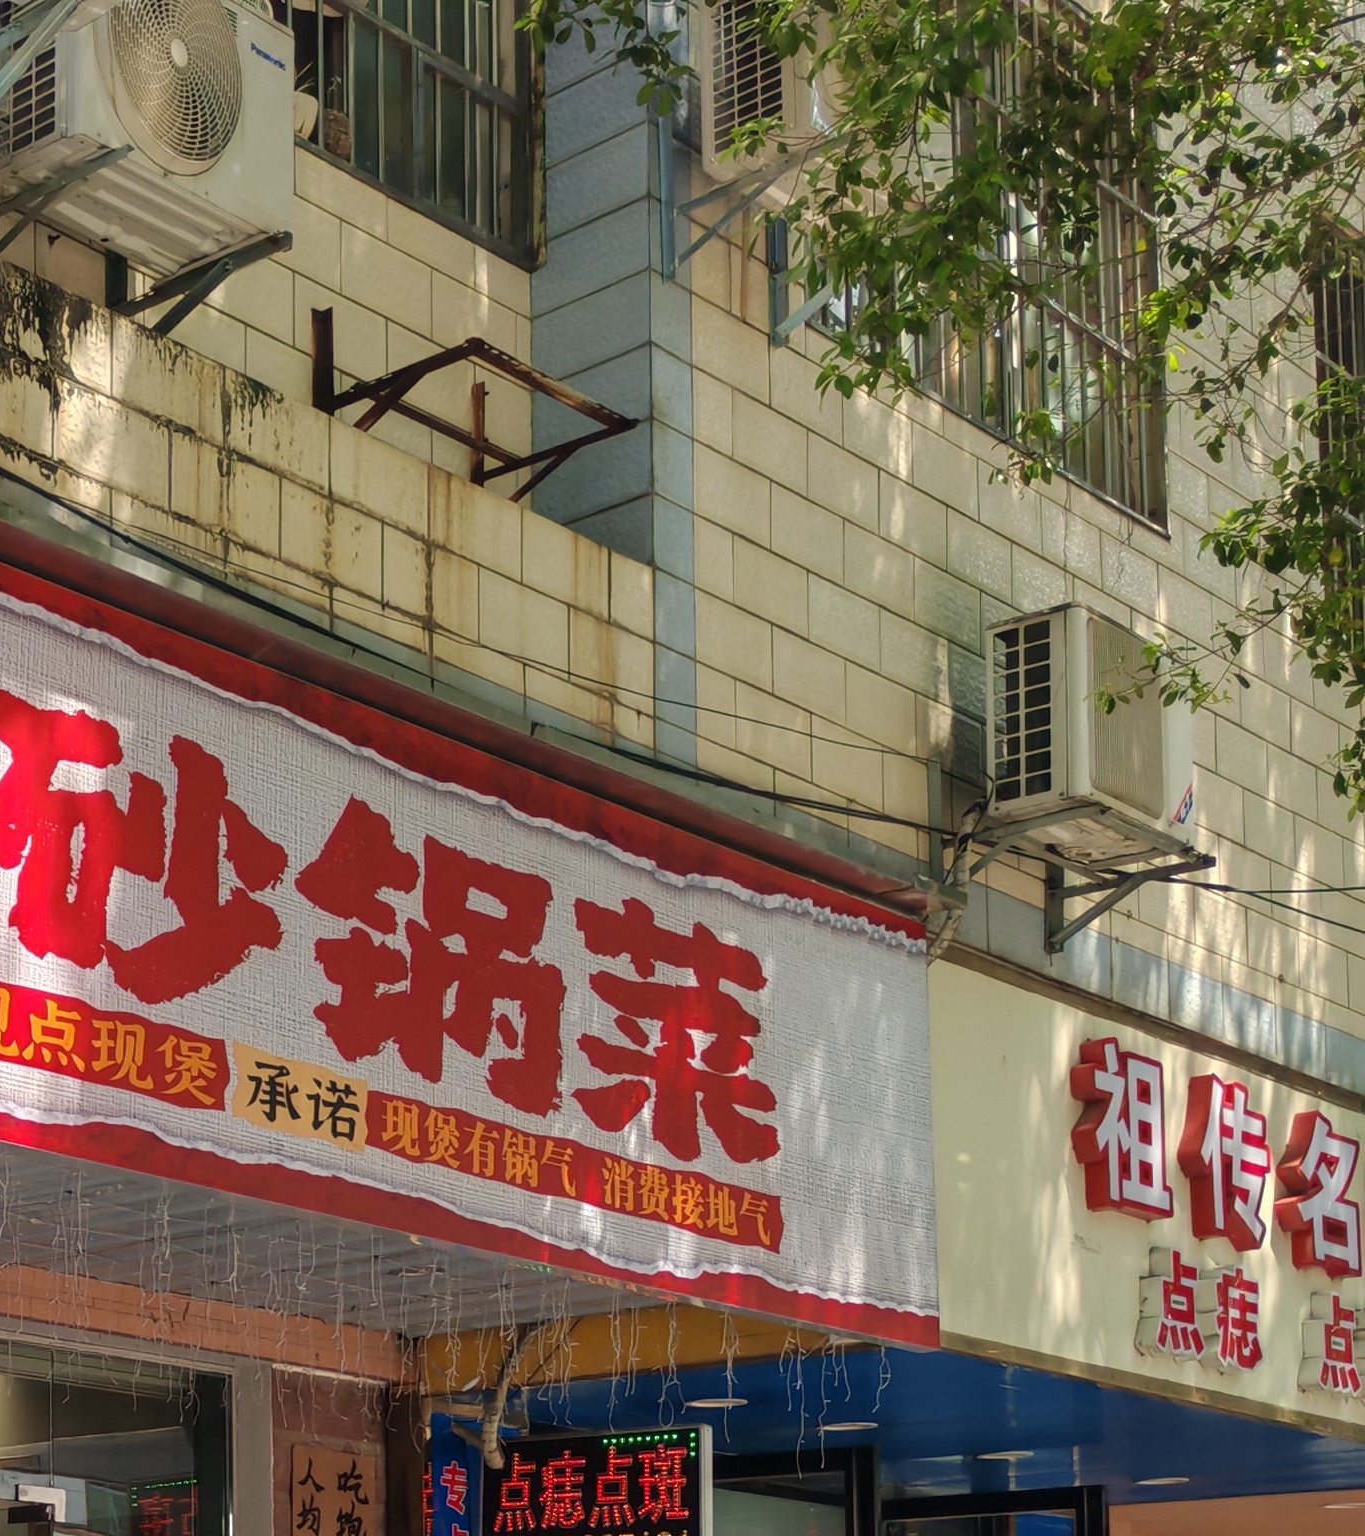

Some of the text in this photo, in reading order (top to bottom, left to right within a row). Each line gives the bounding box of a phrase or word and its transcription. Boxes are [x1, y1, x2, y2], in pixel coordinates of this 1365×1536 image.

[246, 1059, 362, 1144] 承诺
[381, 1100, 773, 1246] 现煲有锅气 消费接地气
[1156, 1249, 1363, 1396] 点痣 点
[493, 1444, 690, 1533] 点痣点斑
